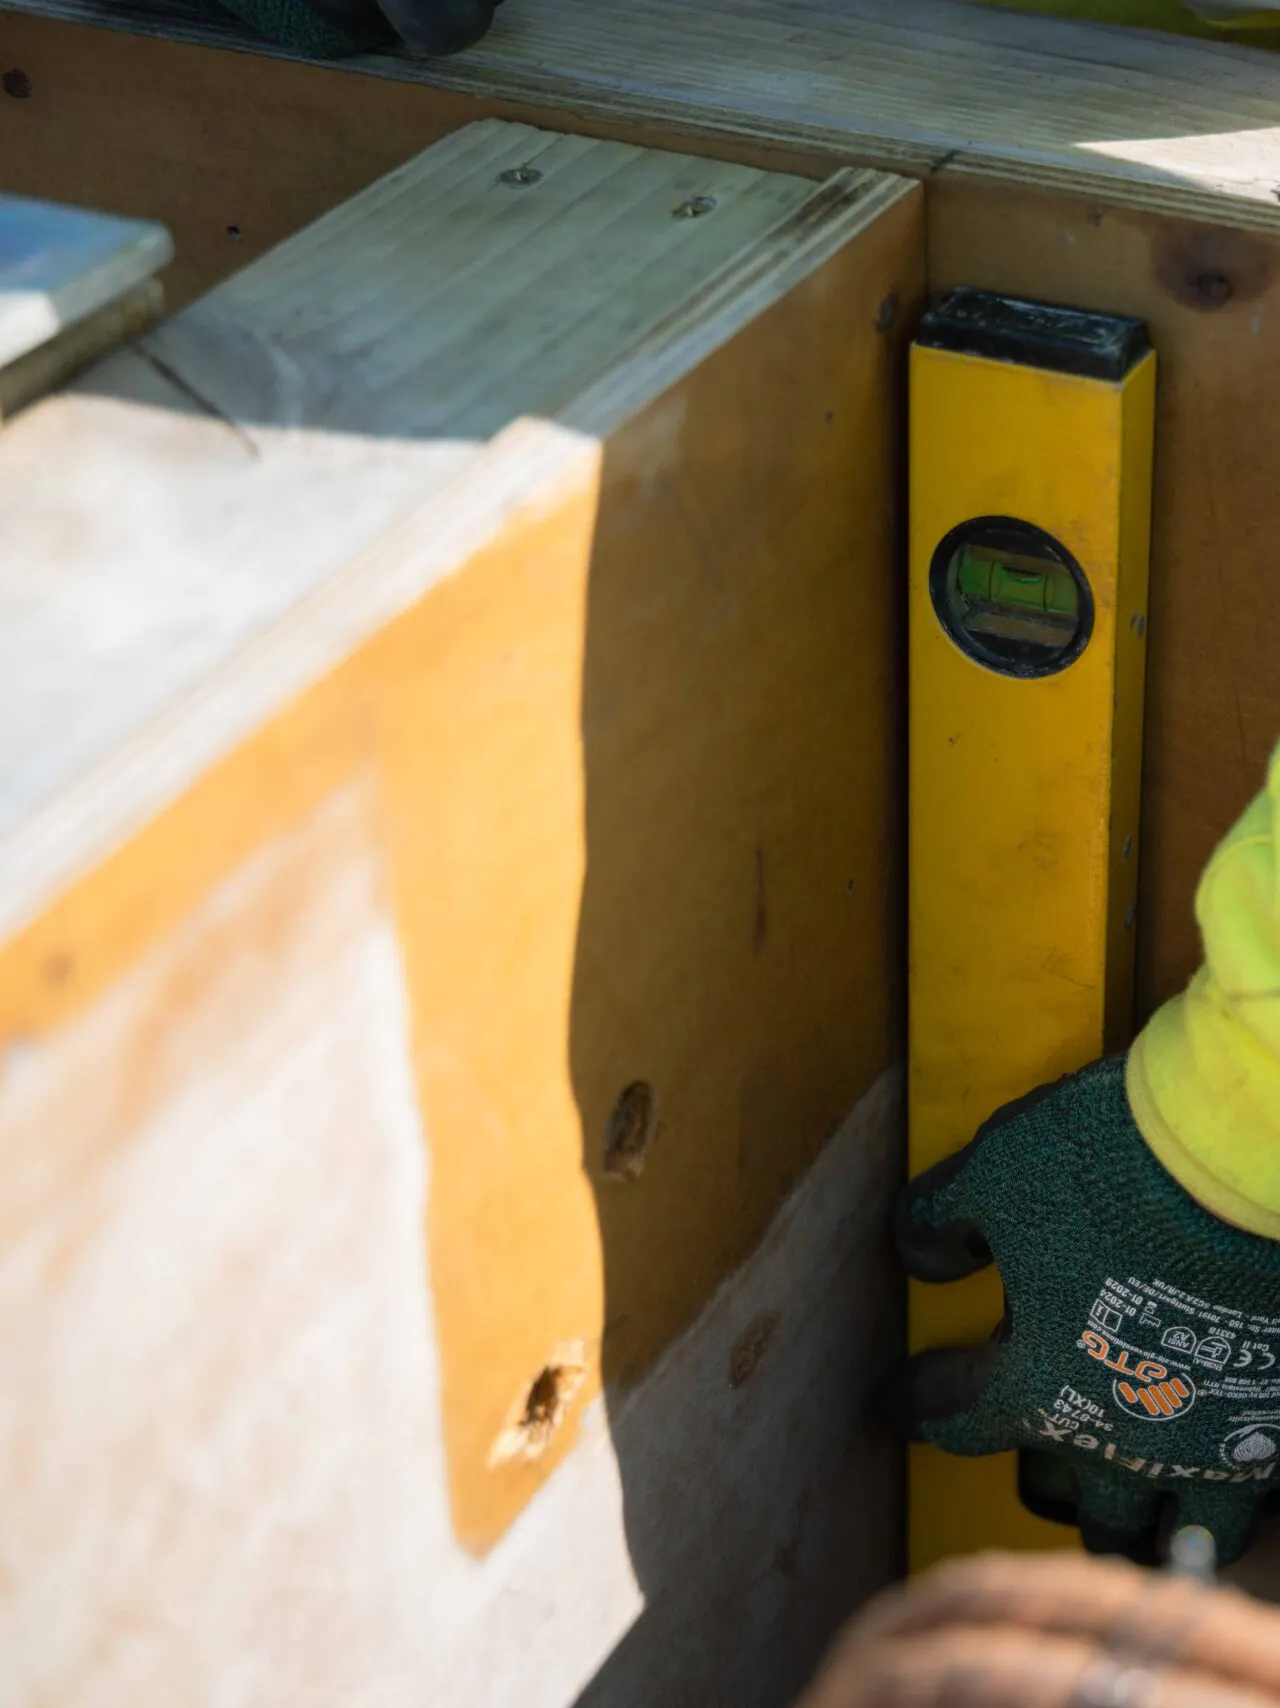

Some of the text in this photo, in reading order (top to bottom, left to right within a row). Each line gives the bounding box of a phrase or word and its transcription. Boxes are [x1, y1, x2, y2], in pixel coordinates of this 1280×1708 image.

[1100, 1288, 1137, 1317] 01-2024
[1105, 1277, 1144, 1306] 01-2029
[1173, 1330, 1191, 1342] A2
[1208, 1326, 1237, 1340] 4331B
[1228, 1319, 1244, 1329] 150
[1053, 1399, 1114, 1432] 34-8743
[1060, 1384, 1105, 1418] 10(XL)
[1039, 1419, 1277, 1484] MaxiFlex
